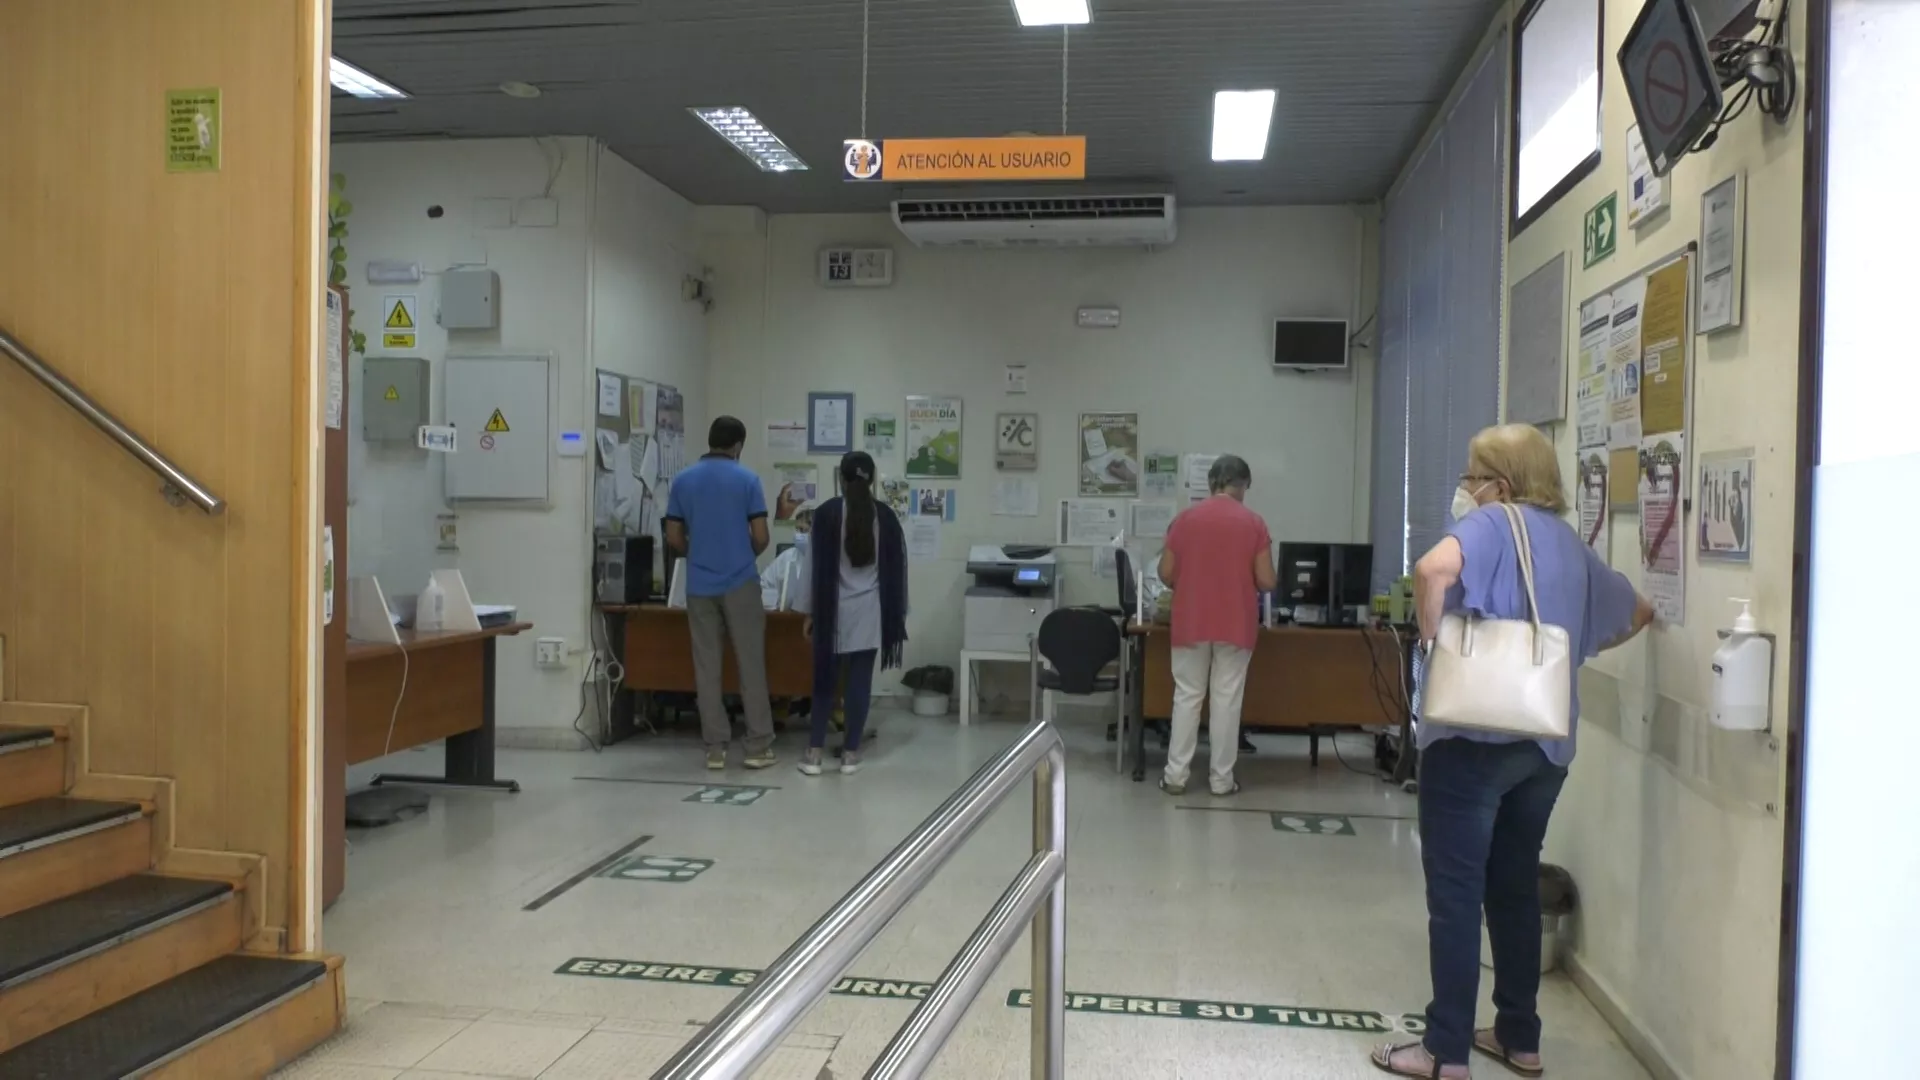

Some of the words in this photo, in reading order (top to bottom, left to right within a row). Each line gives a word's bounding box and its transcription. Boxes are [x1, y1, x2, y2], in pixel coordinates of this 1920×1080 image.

[896, 150, 974, 170] ATENCIÓN
[978, 154, 997, 168] AL
[1001, 151, 1071, 168] USUARIO
[939, 407, 957, 418] DÍA
[568, 960, 722, 983] ESPERE
[730, 972, 756, 984] S
[831, 979, 931, 997] URNO
[1017, 992, 1182, 1014] EPERE
[1197, 1004, 1254, 1021] SU
[1269, 1009, 1426, 1030] TURNO
